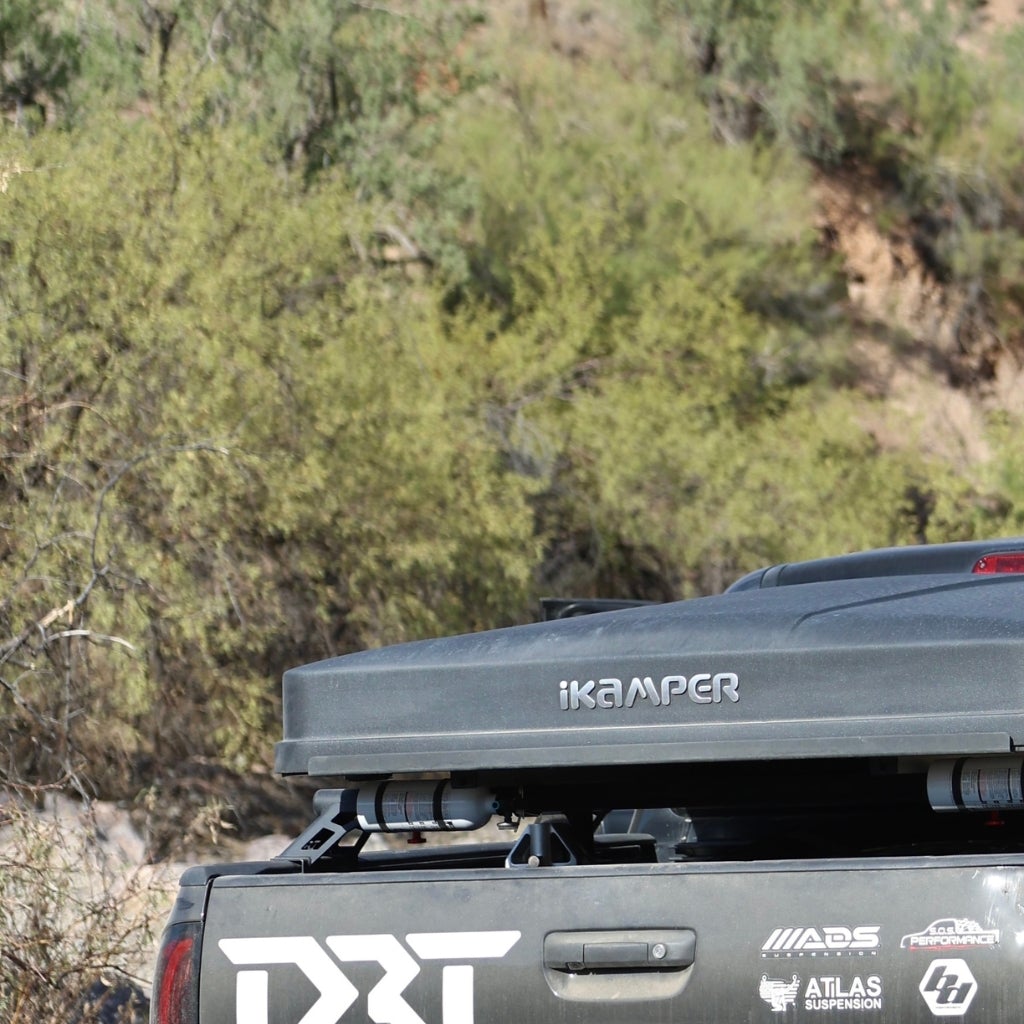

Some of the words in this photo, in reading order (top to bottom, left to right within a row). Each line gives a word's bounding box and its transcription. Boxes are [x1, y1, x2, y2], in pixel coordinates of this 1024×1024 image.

[910, 934, 995, 946] PERFORMANCE
[804, 976, 882, 998] ATLAS
[804, 998, 882, 1010] SUSPENSION
